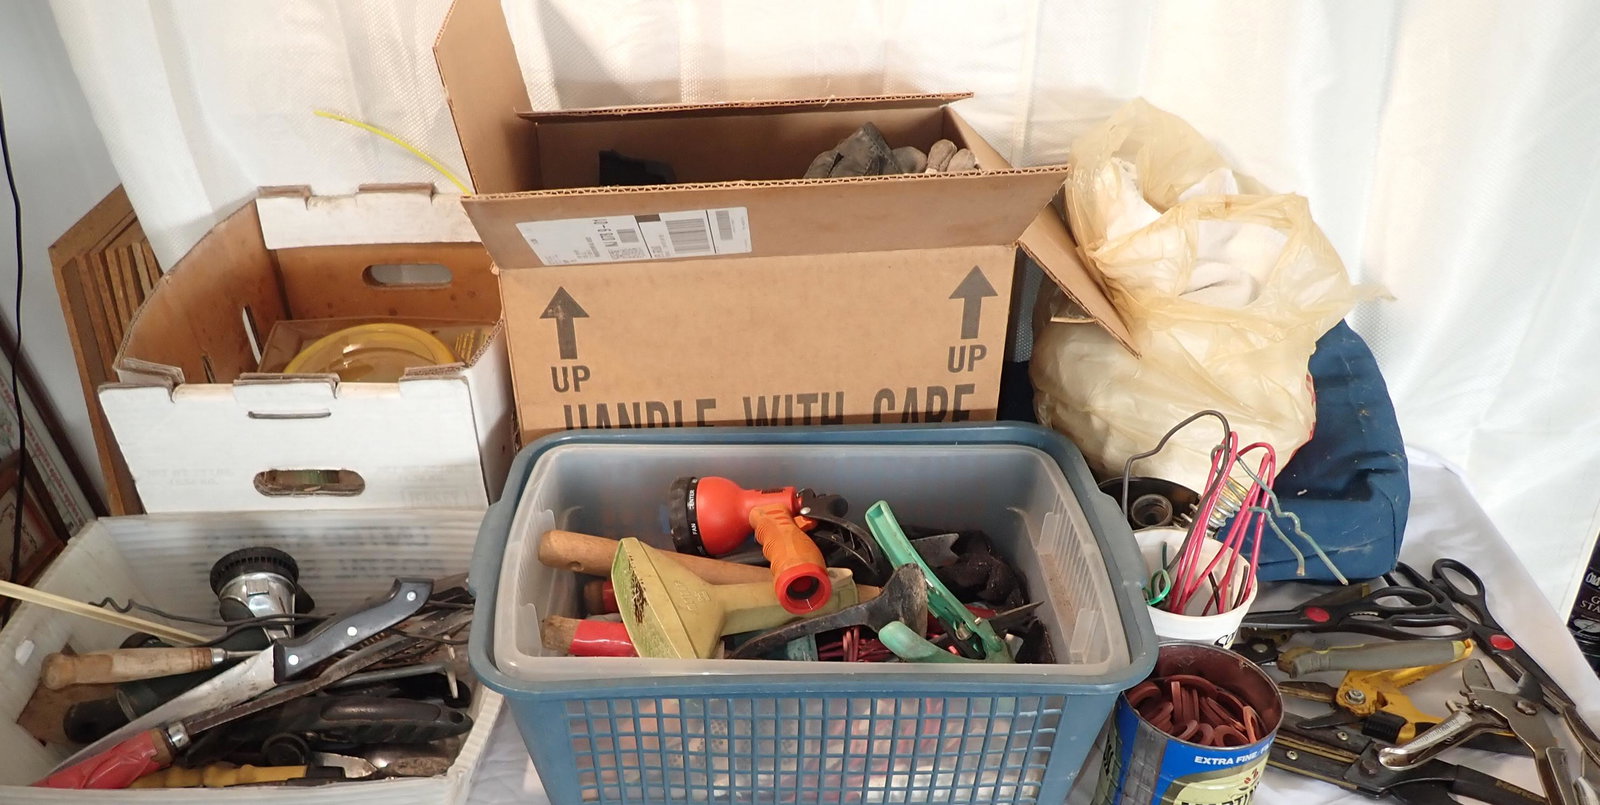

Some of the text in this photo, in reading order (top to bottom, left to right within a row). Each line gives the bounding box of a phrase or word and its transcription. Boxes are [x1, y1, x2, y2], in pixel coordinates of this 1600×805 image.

[947, 344, 987, 373] UP
[550, 365, 591, 393] UP
[742, 391, 844, 428] WITH
[690, 522, 698, 535] FAN
[1194, 751, 1258, 766] EXTRA FINE
